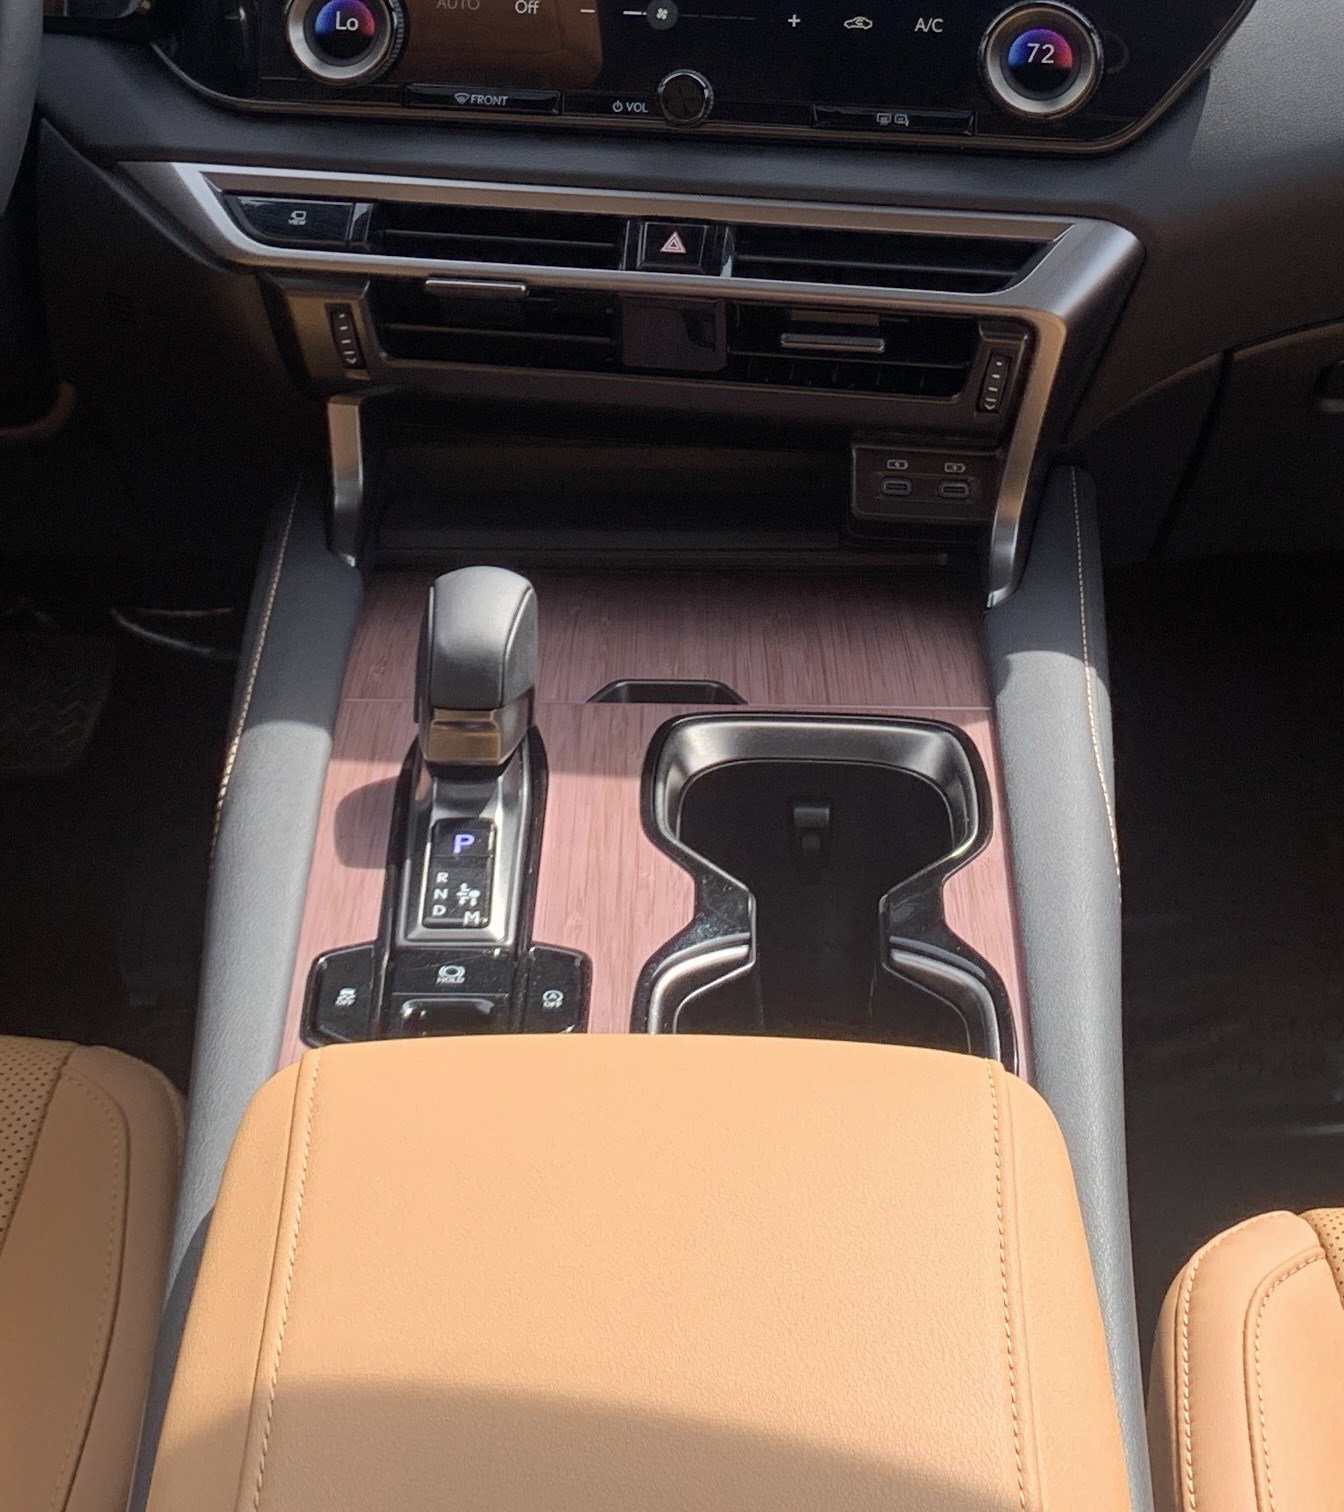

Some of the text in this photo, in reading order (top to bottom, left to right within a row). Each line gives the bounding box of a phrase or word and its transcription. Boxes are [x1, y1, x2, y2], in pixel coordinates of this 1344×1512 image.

[335, 11, 360, 33] Lo
[914, 17, 944, 34] A/C
[1026, 43, 1056, 65] 72
[470, 94, 508, 107] FRONT
[626, 101, 649, 114] VOL
[453, 833, 475, 854] P
[436, 872, 449, 884] R
[433, 888, 449, 900] N
[432, 904, 446, 916] D
[462, 911, 481, 926] M
